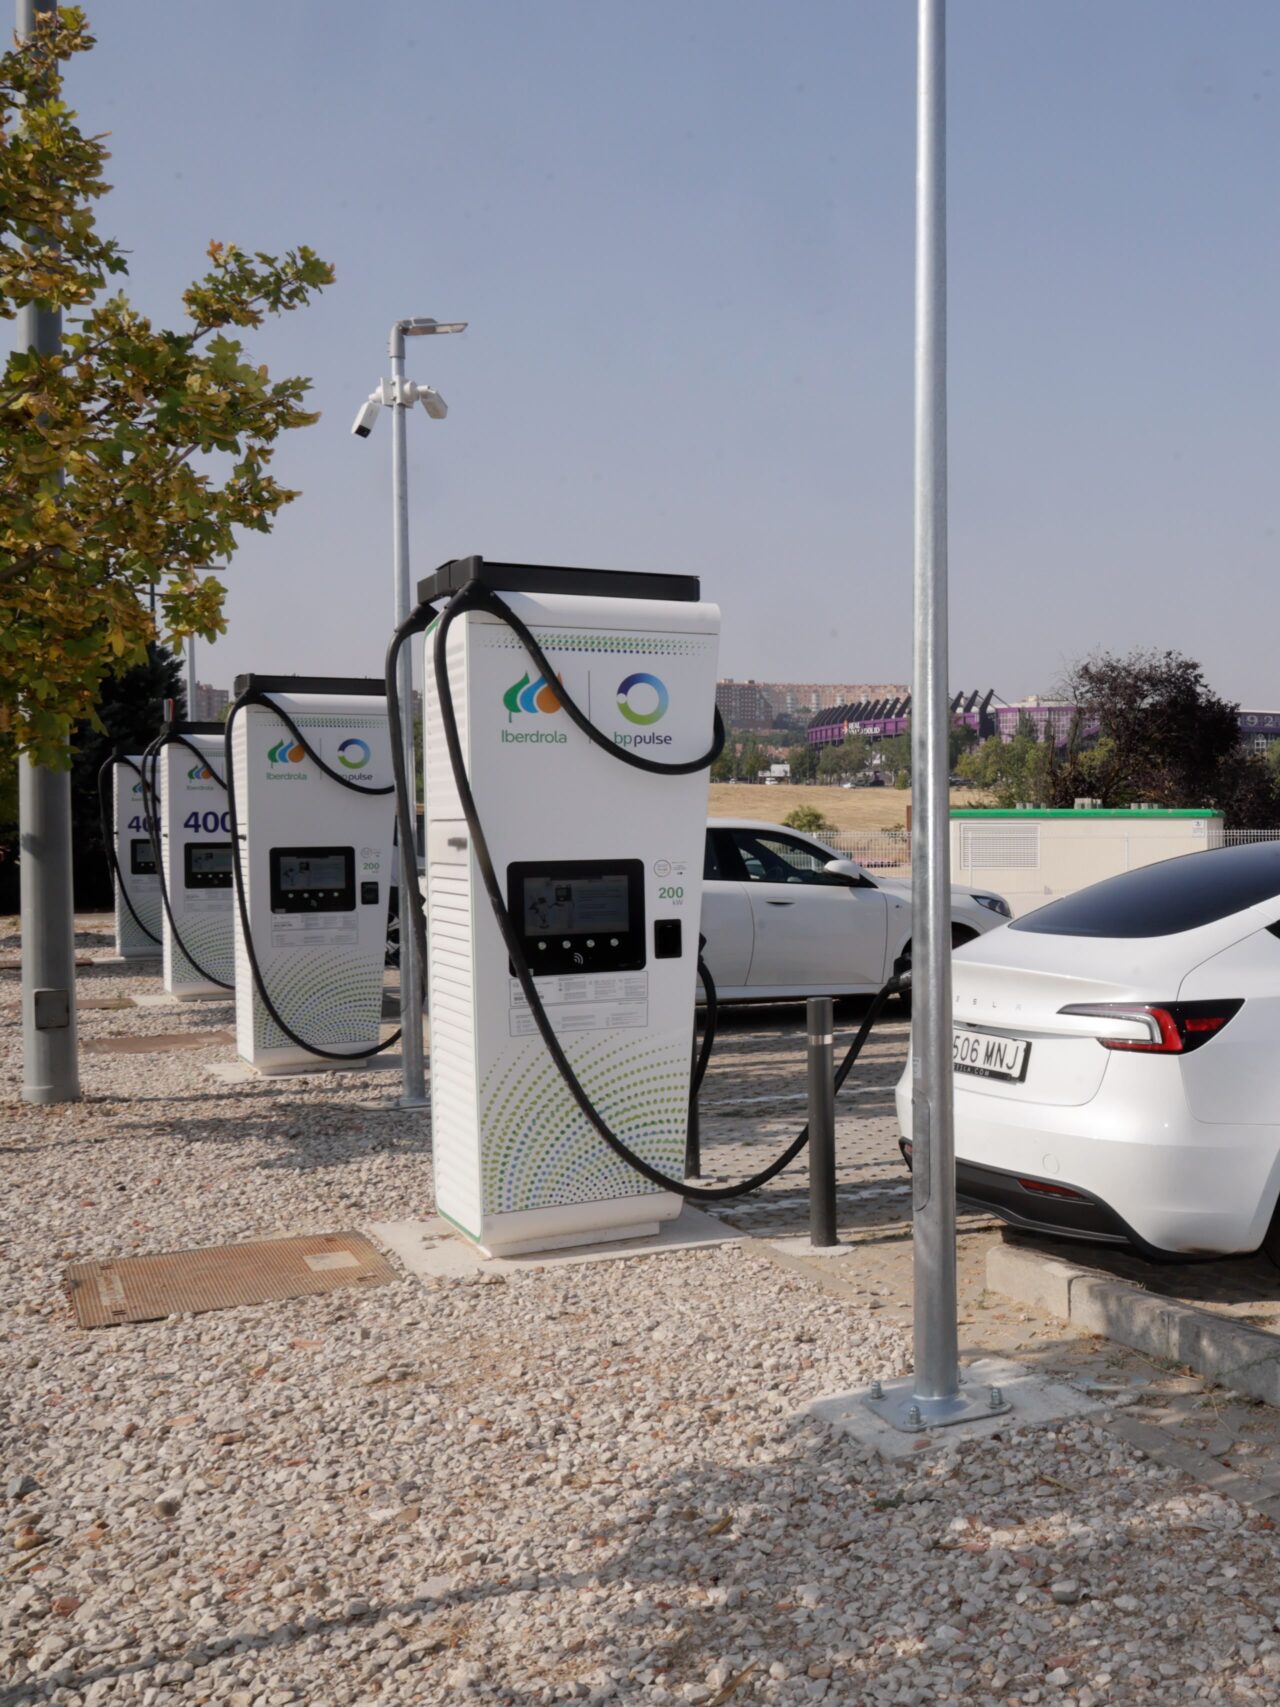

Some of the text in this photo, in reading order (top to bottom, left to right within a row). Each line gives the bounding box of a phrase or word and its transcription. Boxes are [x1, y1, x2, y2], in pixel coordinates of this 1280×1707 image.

[501, 730, 567, 744] Iberdrola
[266, 772, 308, 781] Iberdrola
[362, 862, 380, 870] 200
[658, 886, 684, 899] 200
[983, 1040, 1019, 1071] MNJ
